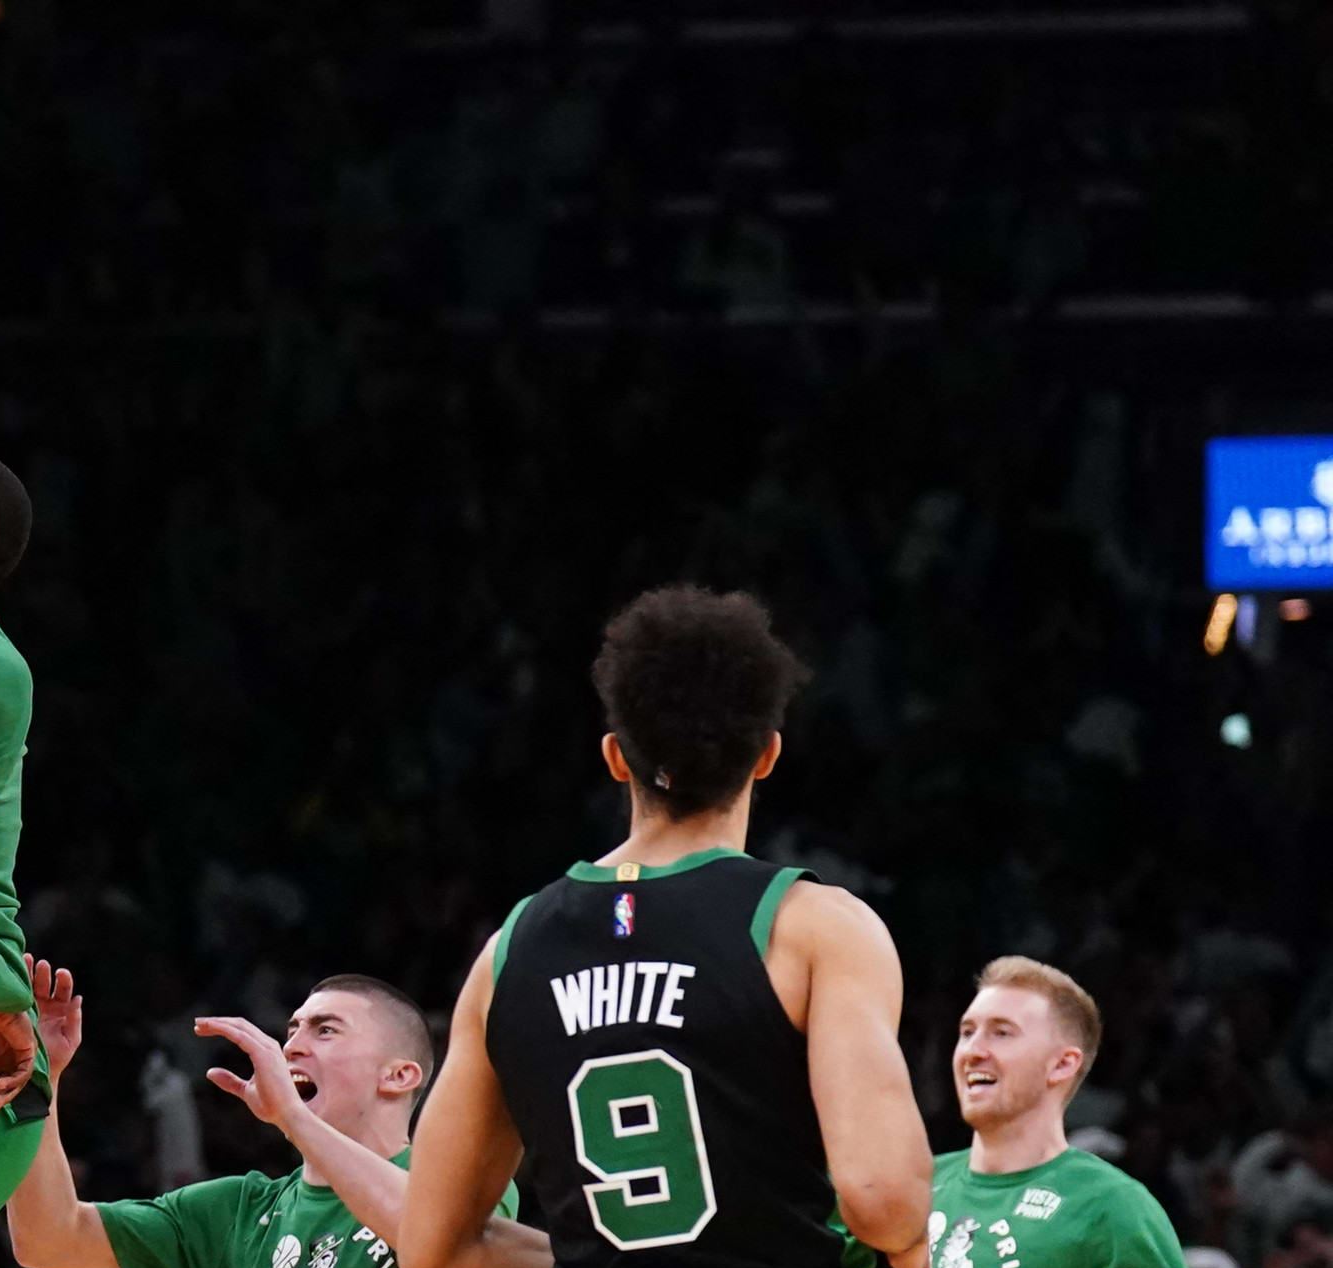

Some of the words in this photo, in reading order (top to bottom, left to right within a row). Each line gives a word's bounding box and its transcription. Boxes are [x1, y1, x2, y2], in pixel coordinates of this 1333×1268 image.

[550, 962, 696, 1036] WHITE
[567, 1048, 718, 1252] 9
[1013, 1201, 1055, 1220] PRINT
[1022, 1188, 1062, 1210] VISTA
